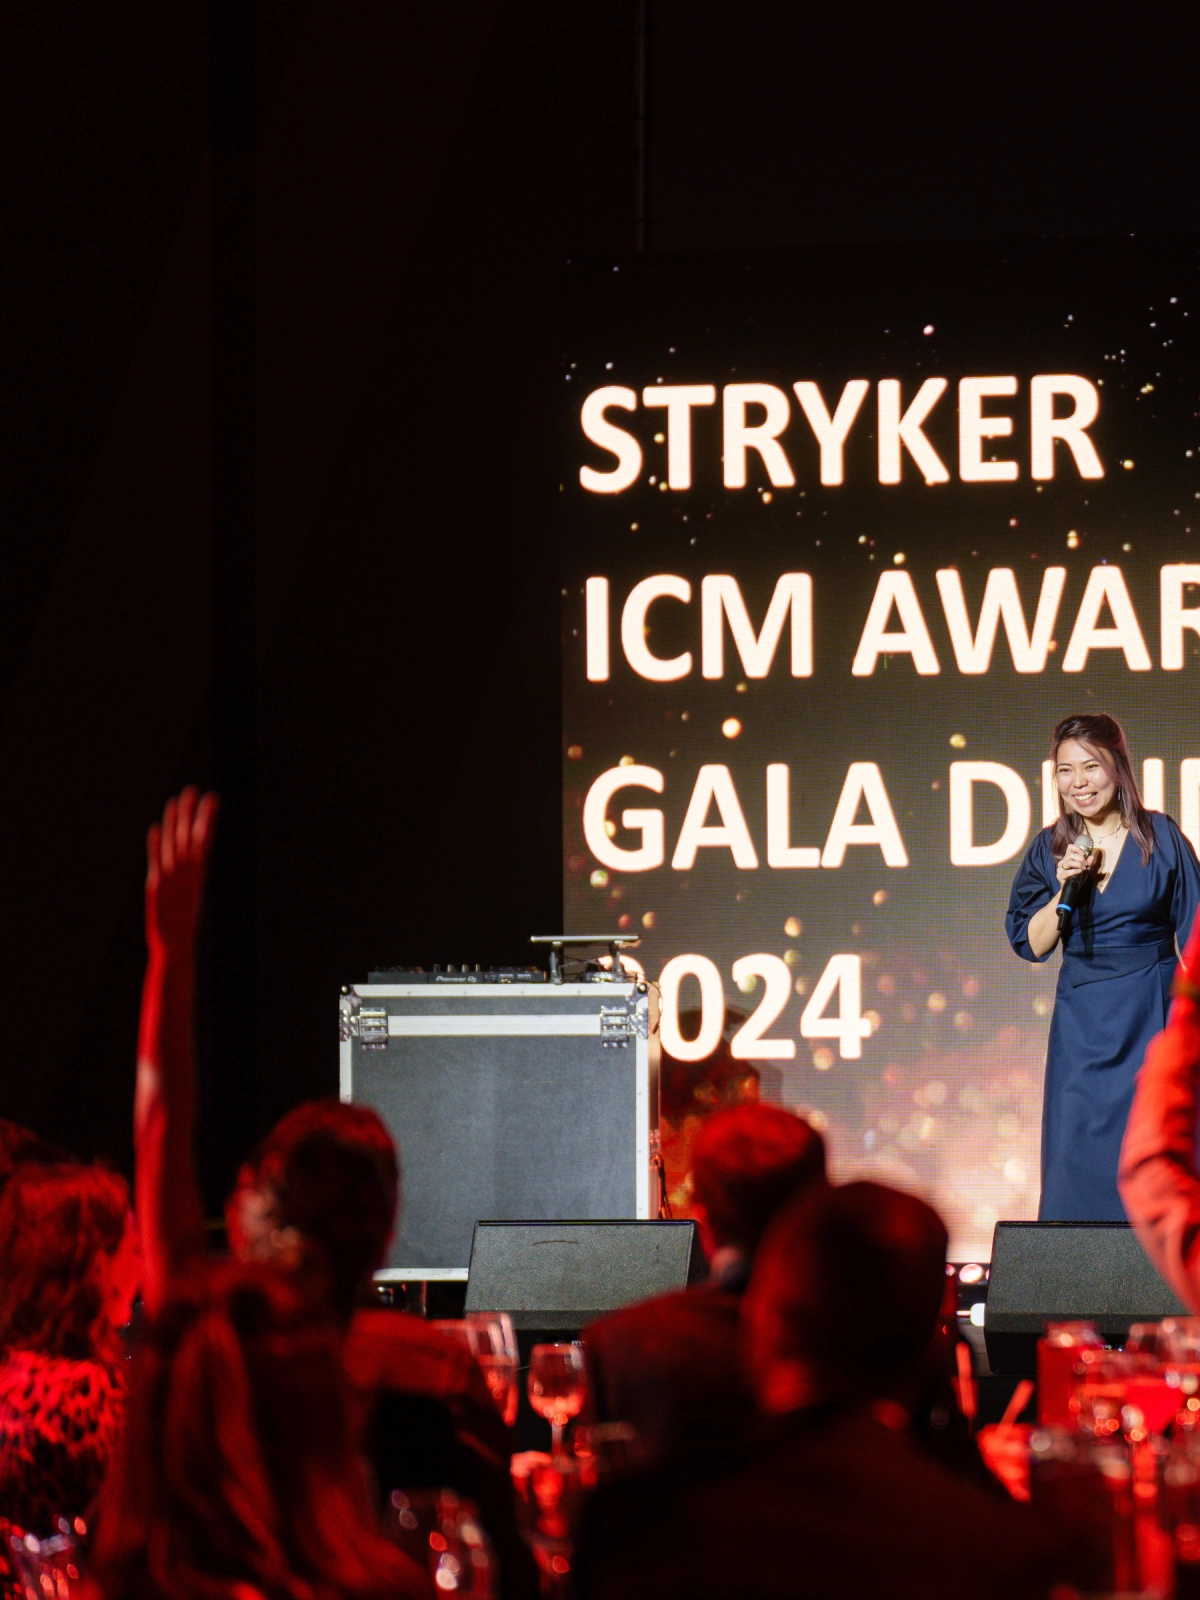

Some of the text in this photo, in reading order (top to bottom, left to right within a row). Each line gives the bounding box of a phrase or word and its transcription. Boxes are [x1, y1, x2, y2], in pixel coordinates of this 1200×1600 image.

[579, 374, 1105, 493] STRYKER
[585, 571, 813, 682] ICM
[582, 757, 910, 872] GALA
